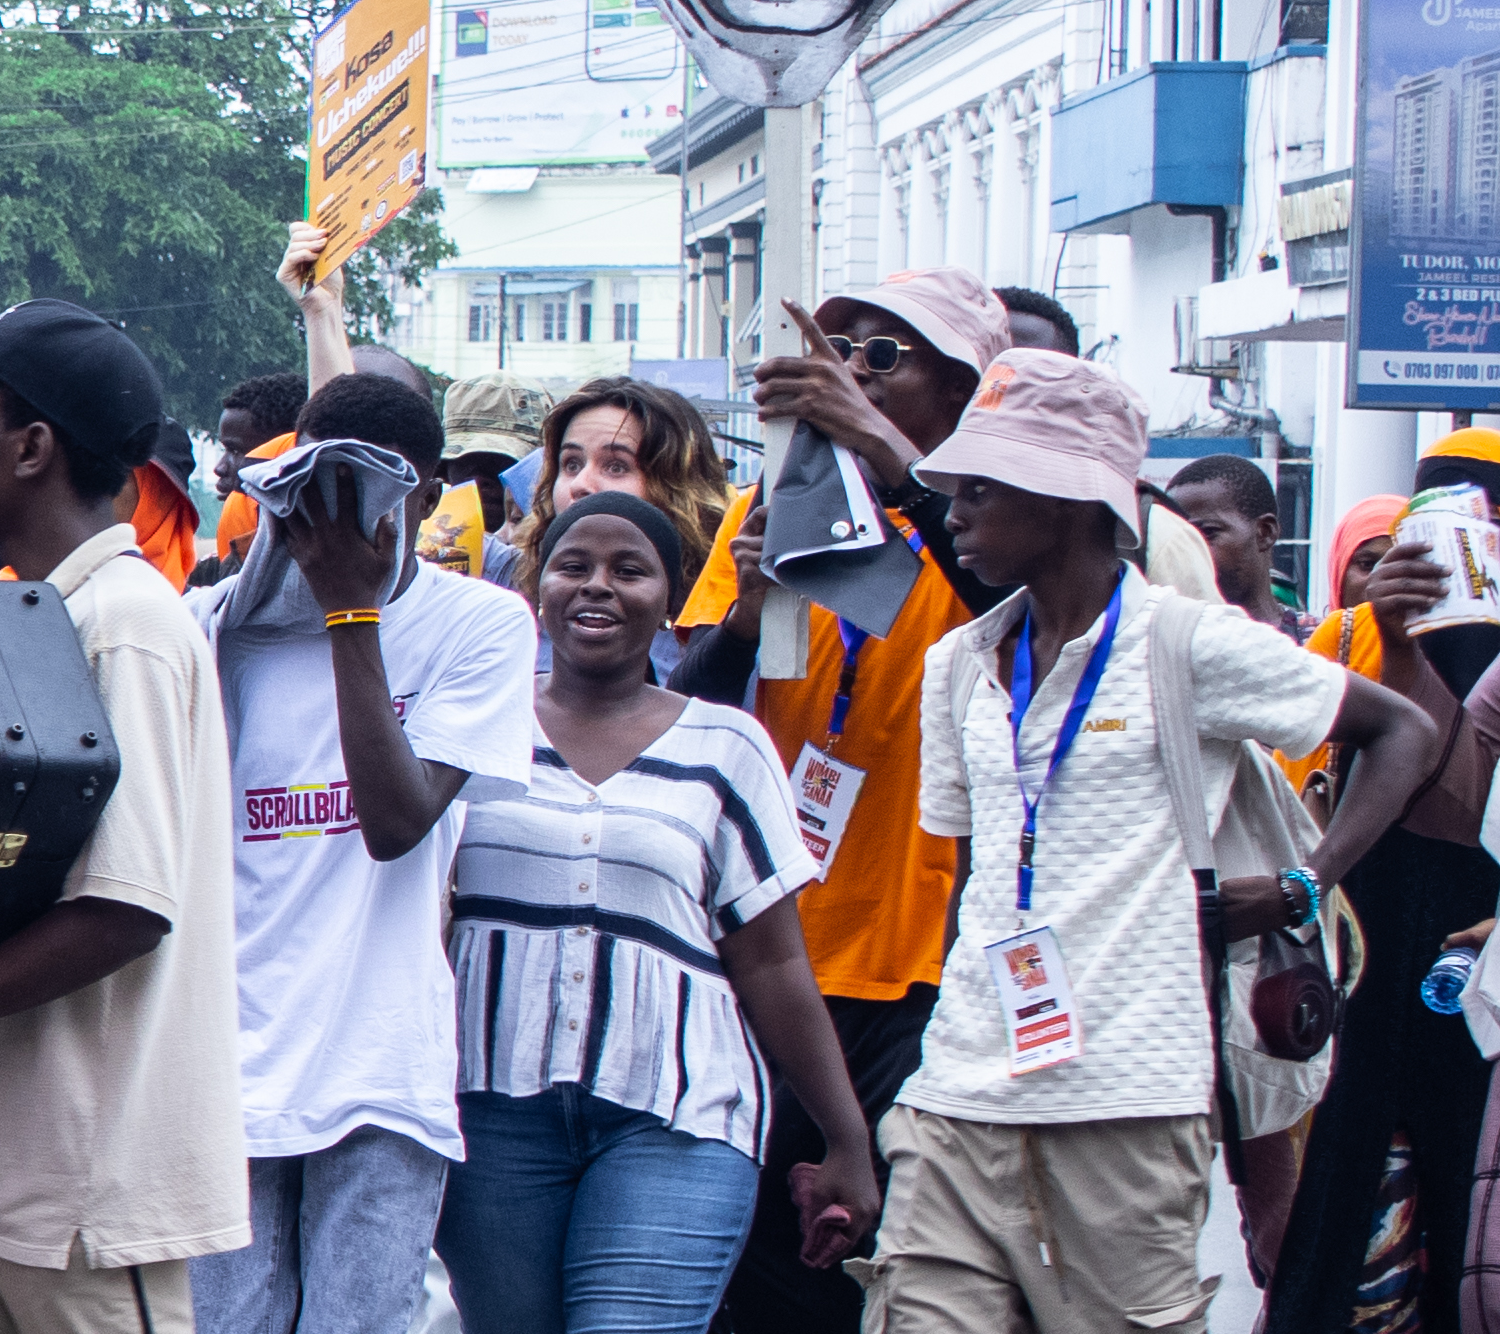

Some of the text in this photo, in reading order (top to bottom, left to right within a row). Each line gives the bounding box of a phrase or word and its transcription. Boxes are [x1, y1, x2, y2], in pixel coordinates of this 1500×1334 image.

[492, 15, 557, 29] DOWNLOAD
[493, 35, 529, 46] TODAY
[344, 30, 394, 91] Kosa
[317, 25, 427, 147] Uchekwe!!!
[327, 128, 360, 170] MUSIC
[362, 85, 410, 139] CONCERT
[1400, 255, 1500, 270] TUDOR, MO
[1418, 272, 1500, 283] JAMEEL RESI
[1417, 288, 1426, 301] 2
[1440, 289, 1449, 301] 3
[1453, 289, 1477, 302] BED
[1480, 289, 1500, 302] PLU
[804, 757, 841, 784] WIMBI
[803, 786, 834, 808] SANAA
